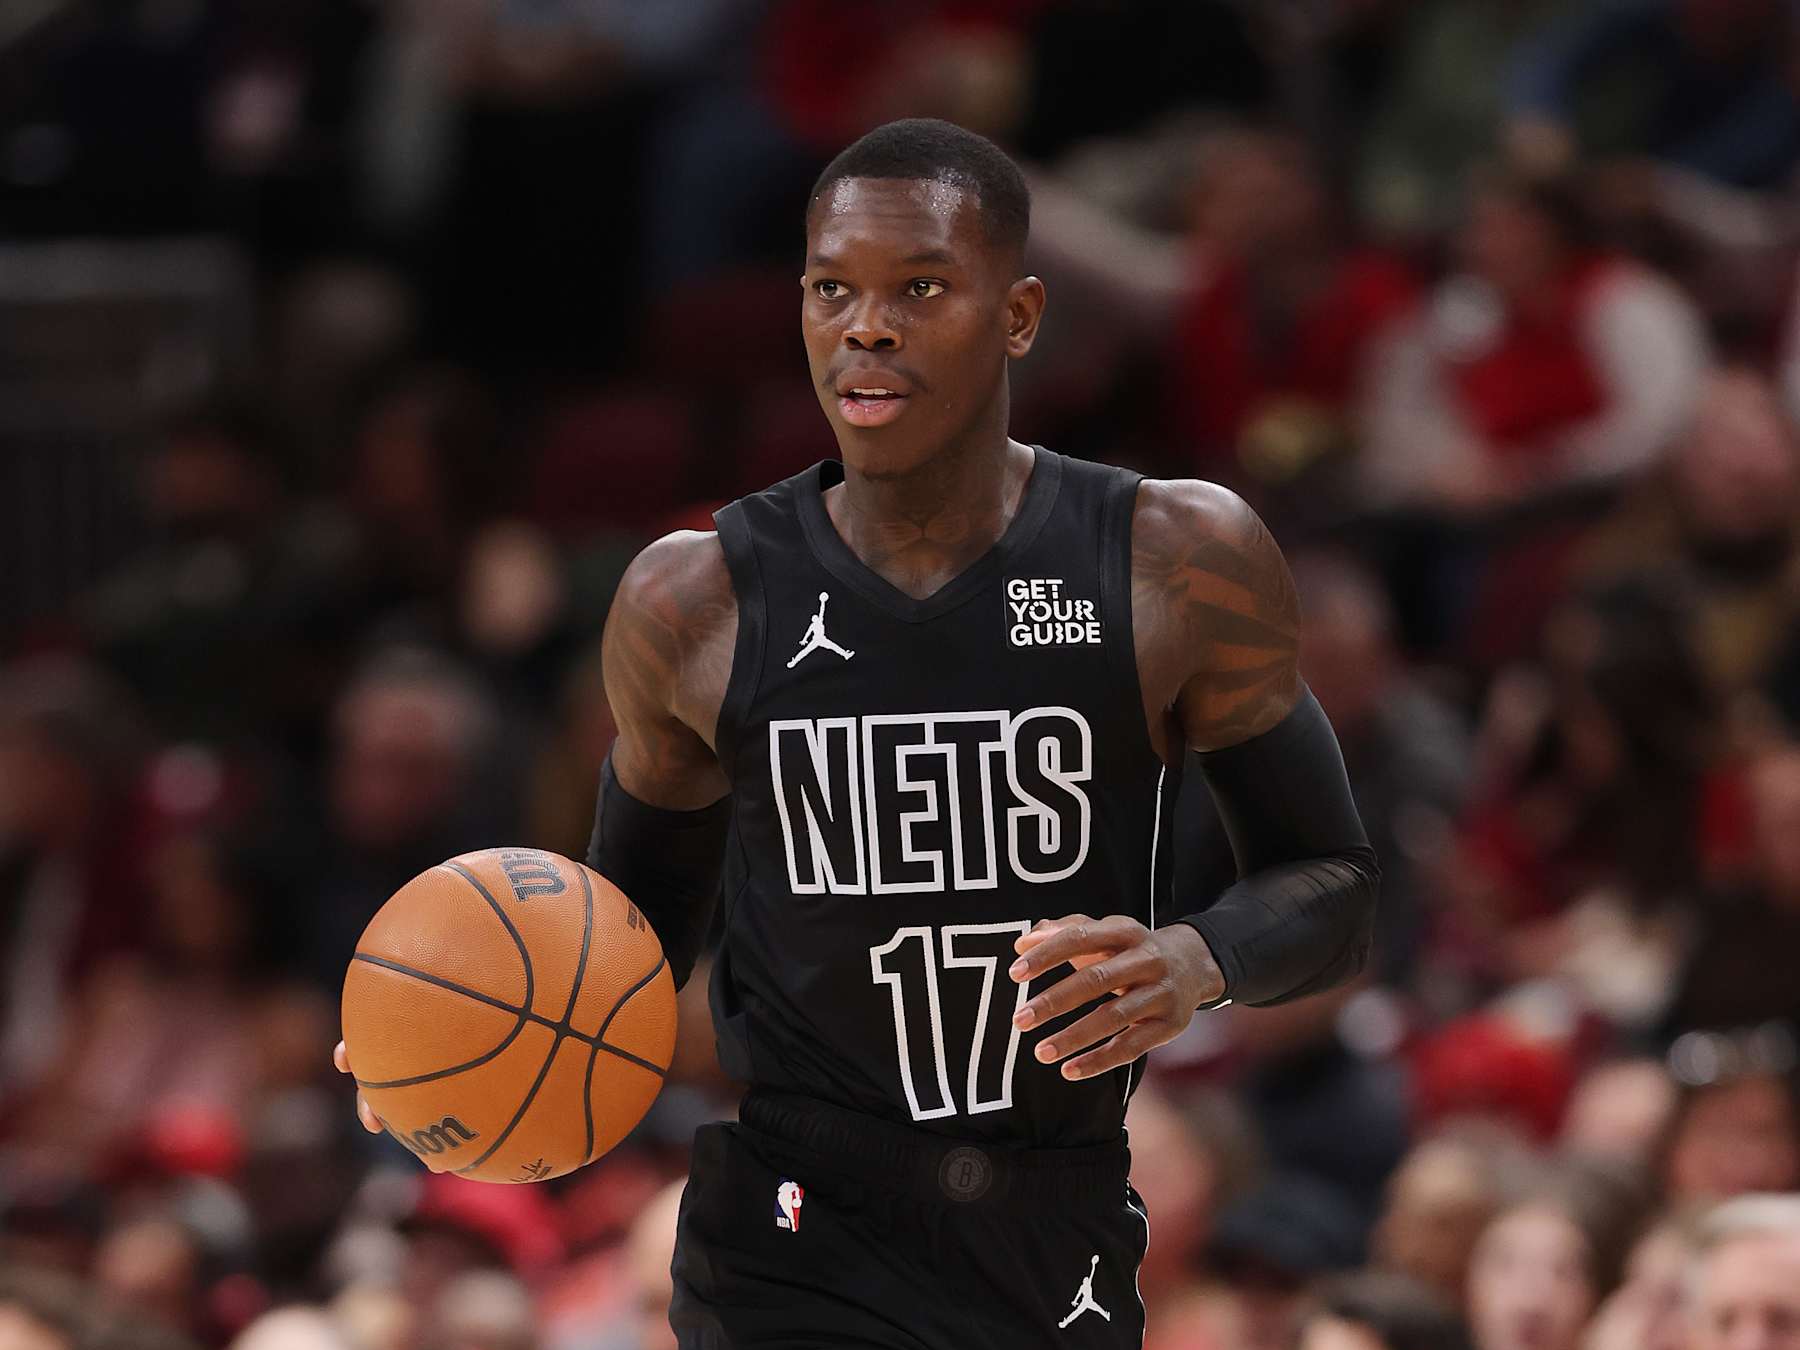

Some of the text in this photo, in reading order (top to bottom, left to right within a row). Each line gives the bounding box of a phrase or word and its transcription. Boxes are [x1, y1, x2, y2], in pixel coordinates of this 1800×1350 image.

[1007, 578, 1064, 601] GET
[1008, 599, 1096, 623] YOUR
[1010, 621, 1102, 647] GUIDE
[769, 706, 1092, 896] NETS
[869, 919, 1032, 1122] 17
